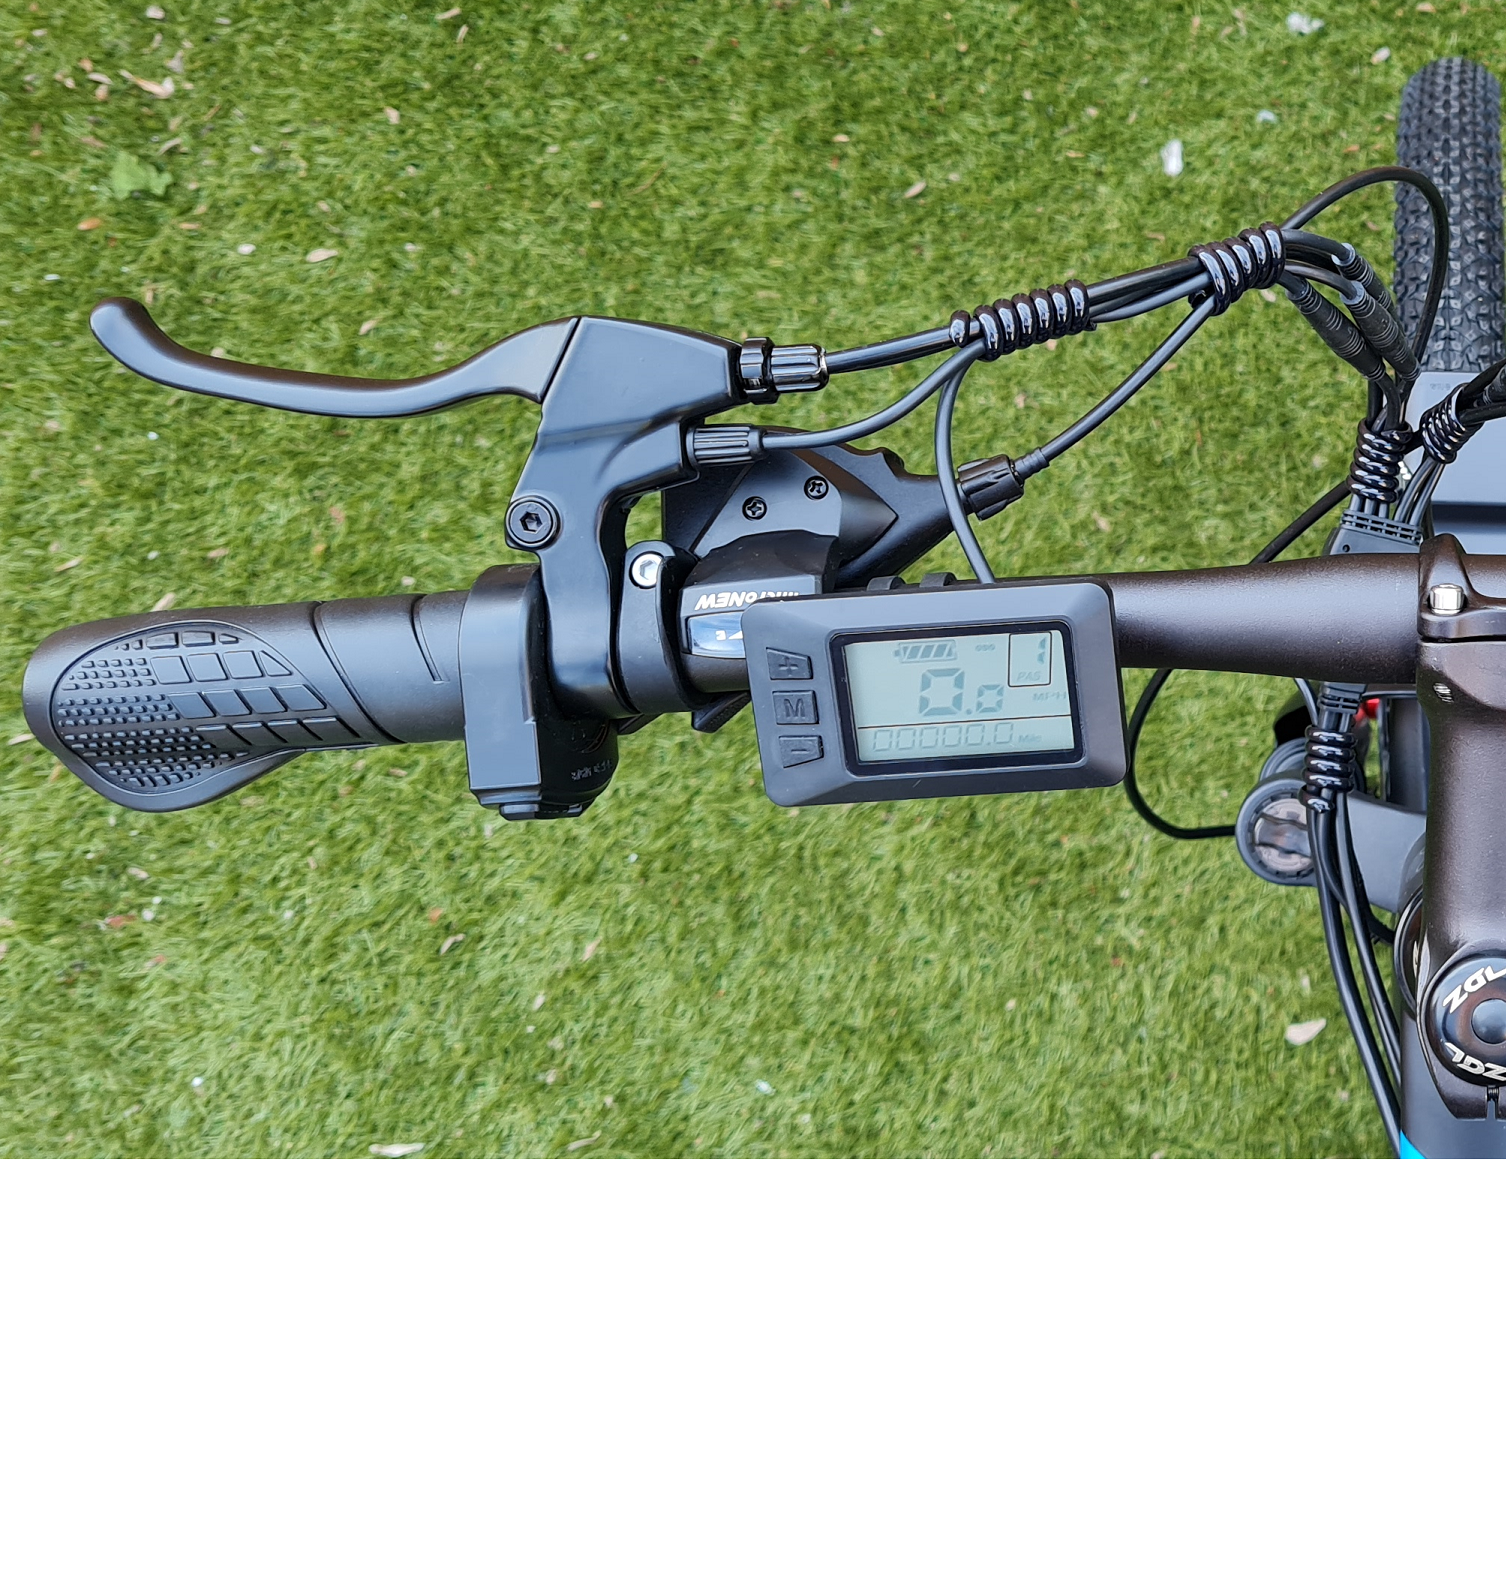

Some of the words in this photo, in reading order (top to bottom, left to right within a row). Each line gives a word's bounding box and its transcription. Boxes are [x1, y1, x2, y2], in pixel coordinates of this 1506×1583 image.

[918, 667, 1005, 717] 0.0
[785, 697, 806, 720] M
[872, 722, 1014, 751] 00000.0
